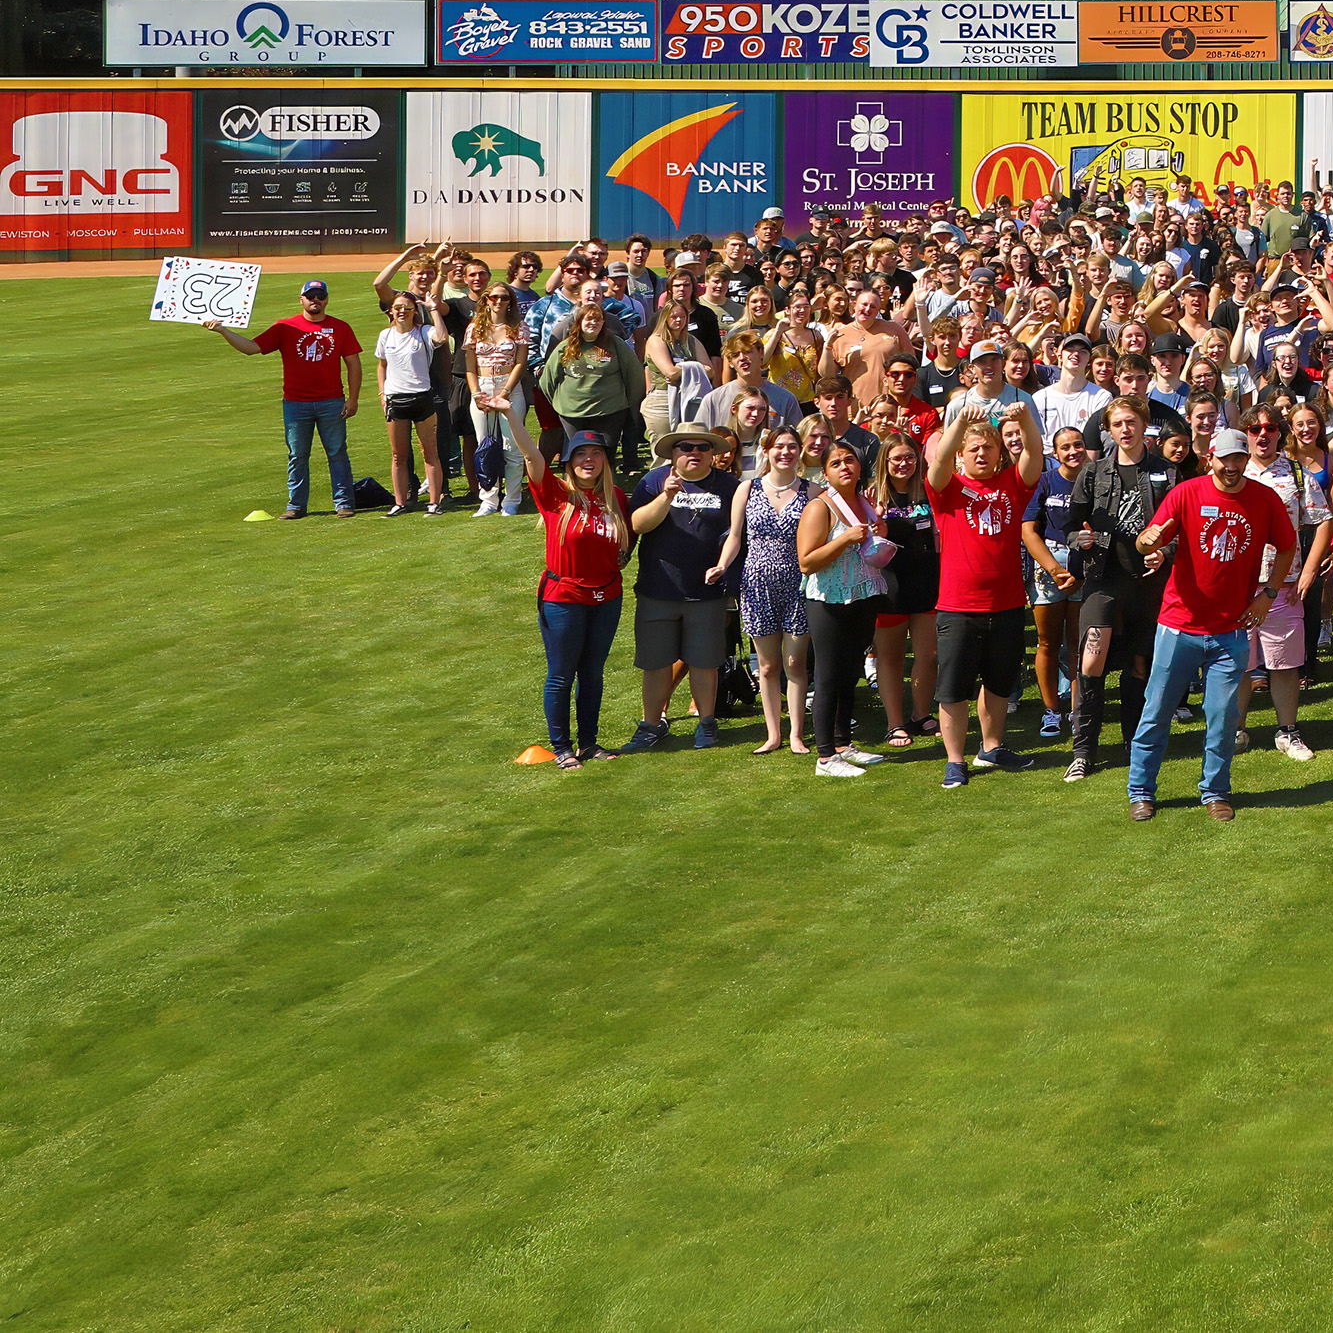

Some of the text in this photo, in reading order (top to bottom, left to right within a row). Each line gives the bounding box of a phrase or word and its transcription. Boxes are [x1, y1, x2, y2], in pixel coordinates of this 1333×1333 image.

[941, 4, 1075, 20] COLDWELL
[1118, 5, 1239, 23] HILLCREST
[138, 23, 395, 47] IDAHO FOREST
[446, 20, 521, 44] Boyer
[959, 23, 1057, 39] BANKER
[458, 29, 519, 56] Gravel
[530, 37, 651, 49] ROCK GRAVEL SAND
[664, 35, 870, 59] SPORTS
[963, 45, 1055, 55] TOMLINSON
[199, 51, 327, 62] GROUP
[960, 55, 1058, 65] ASSOCIATES
[268, 114, 371, 132] FISHER
[1022, 101, 1239, 140] TEAM BUS STOP
[234, 167, 276, 175] Protecting
[666, 162, 767, 176] BANNER
[9, 168, 171, 197] GNC
[698, 178, 768, 193] BANK
[44, 198, 81, 207] LIVE
[457, 188, 585, 204] DAVIDSON
[67, 227, 185, 238] MOSCOW PULLMAN
